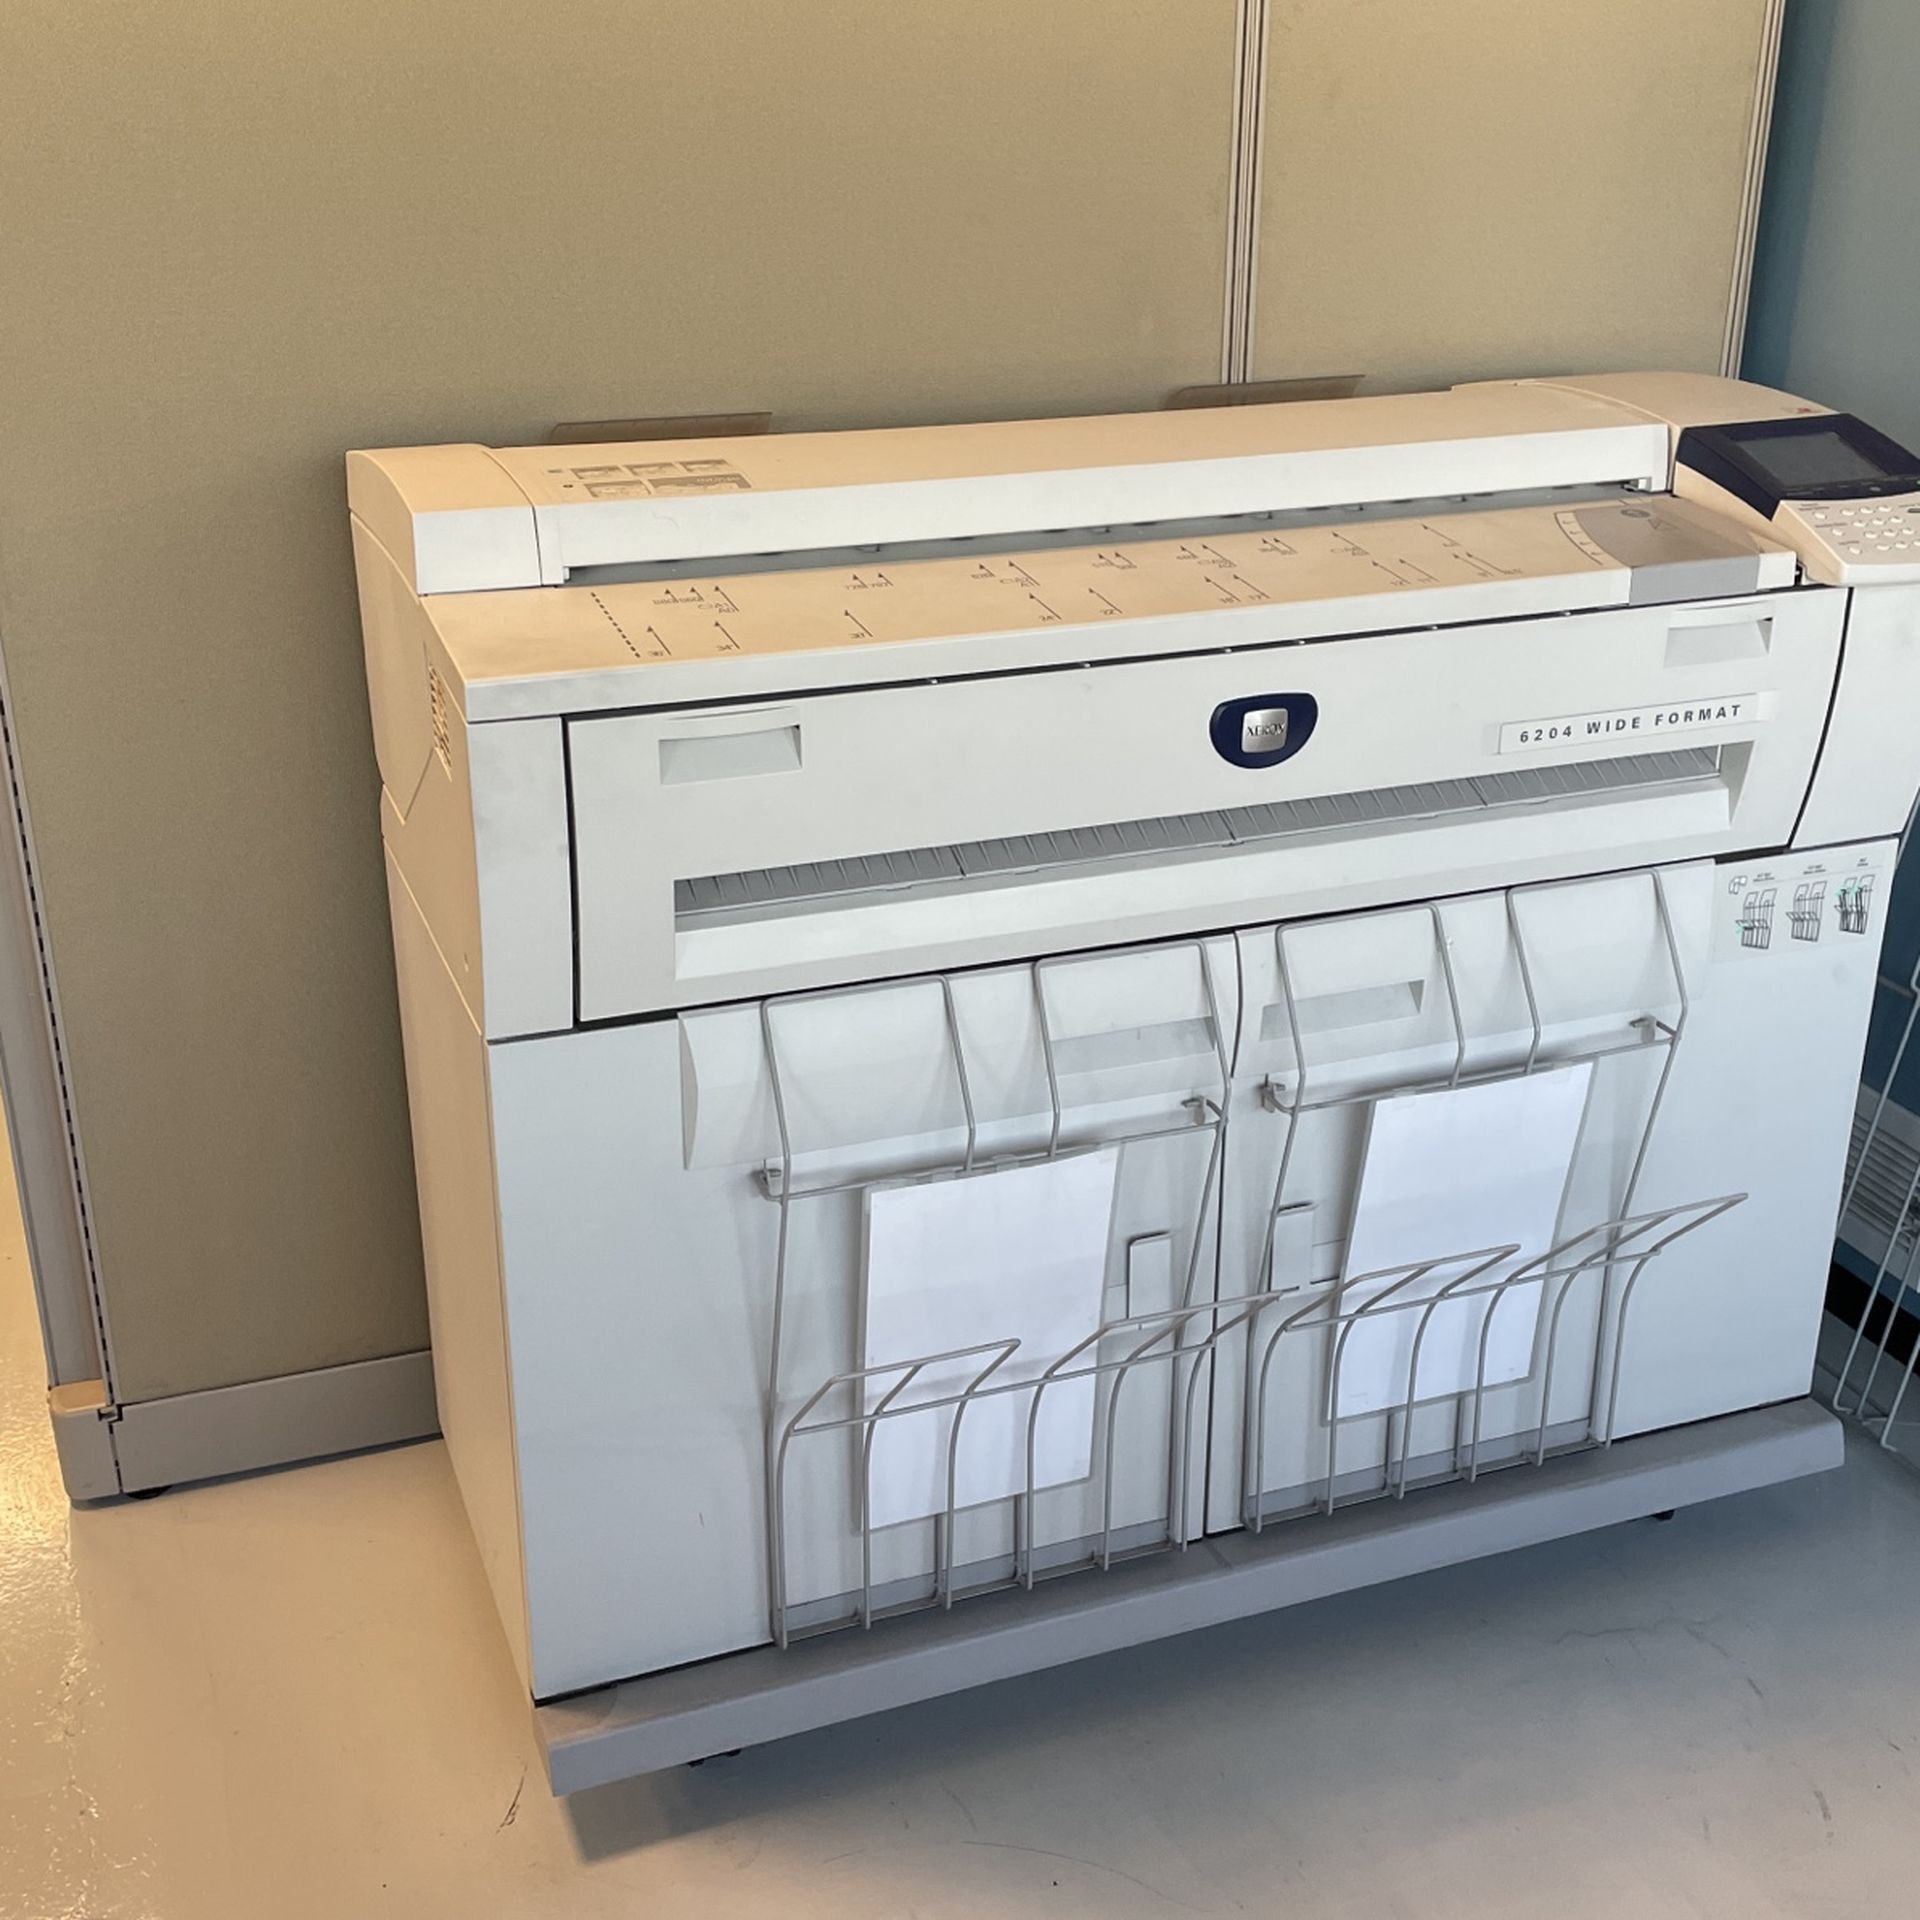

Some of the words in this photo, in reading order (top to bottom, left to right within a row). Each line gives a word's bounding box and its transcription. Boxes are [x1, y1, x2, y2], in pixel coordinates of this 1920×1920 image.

[1247, 722, 1285, 736] XEROX
[1519, 725, 1572, 743] 6204
[1586, 717, 1641, 734] WIDE
[1654, 705, 1741, 726] FORMAT
